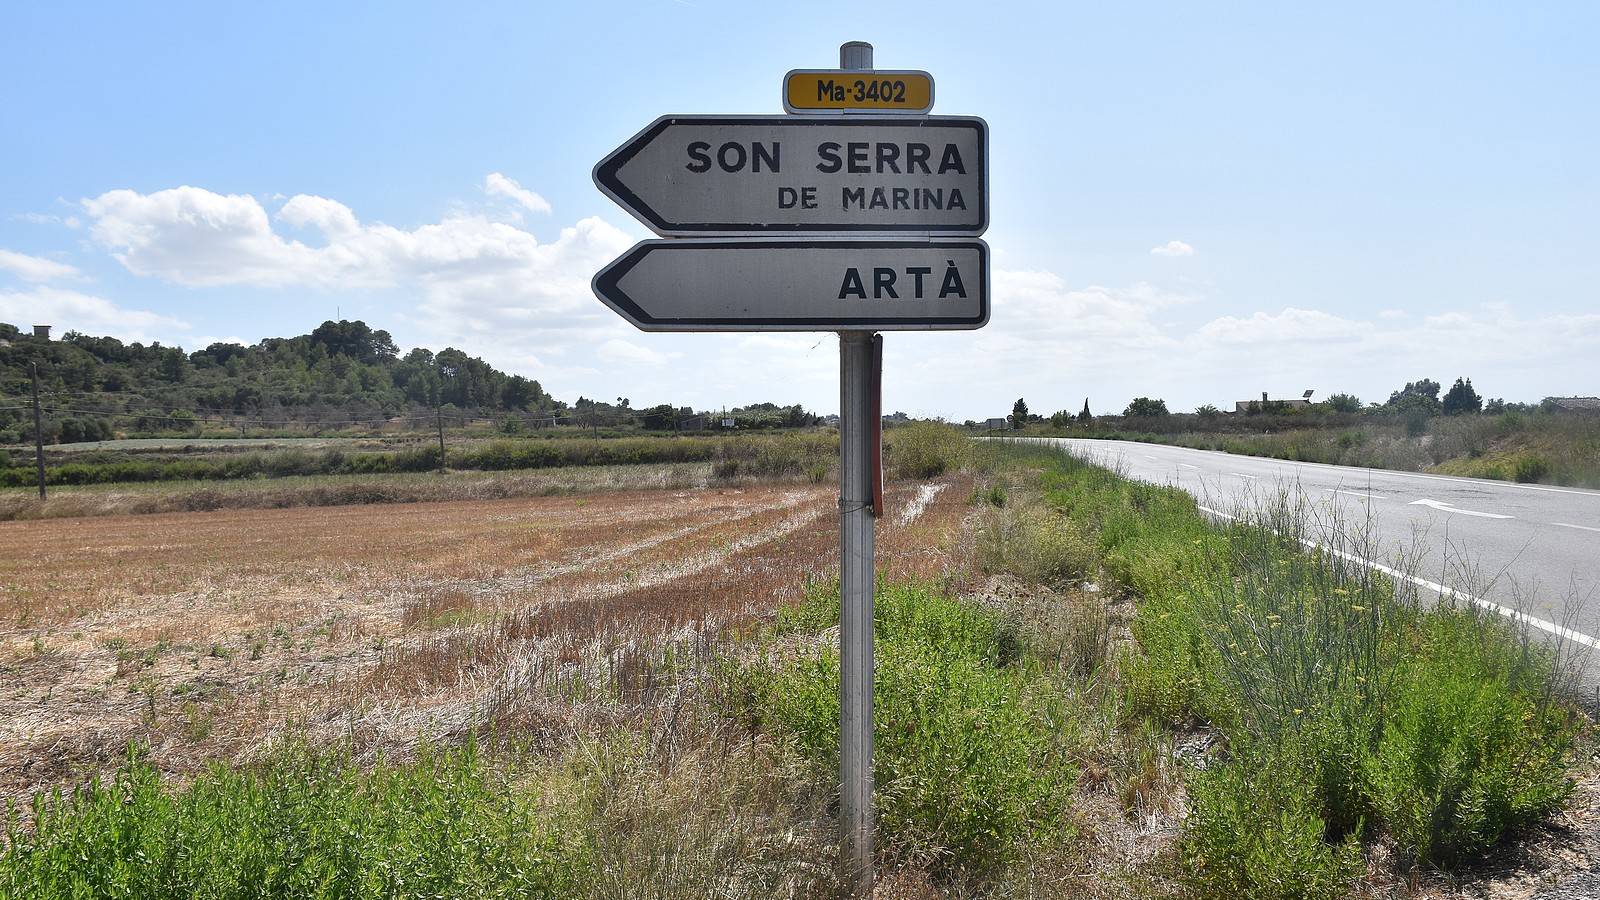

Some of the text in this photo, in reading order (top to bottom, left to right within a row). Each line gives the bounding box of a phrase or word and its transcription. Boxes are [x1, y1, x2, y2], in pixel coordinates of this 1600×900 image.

[818, 80, 906, 103] Ma-3402
[685, 141, 967, 175] SON SERRA
[778, 187, 967, 211] DE MARINA
[838, 260, 968, 299] ARTÀ
